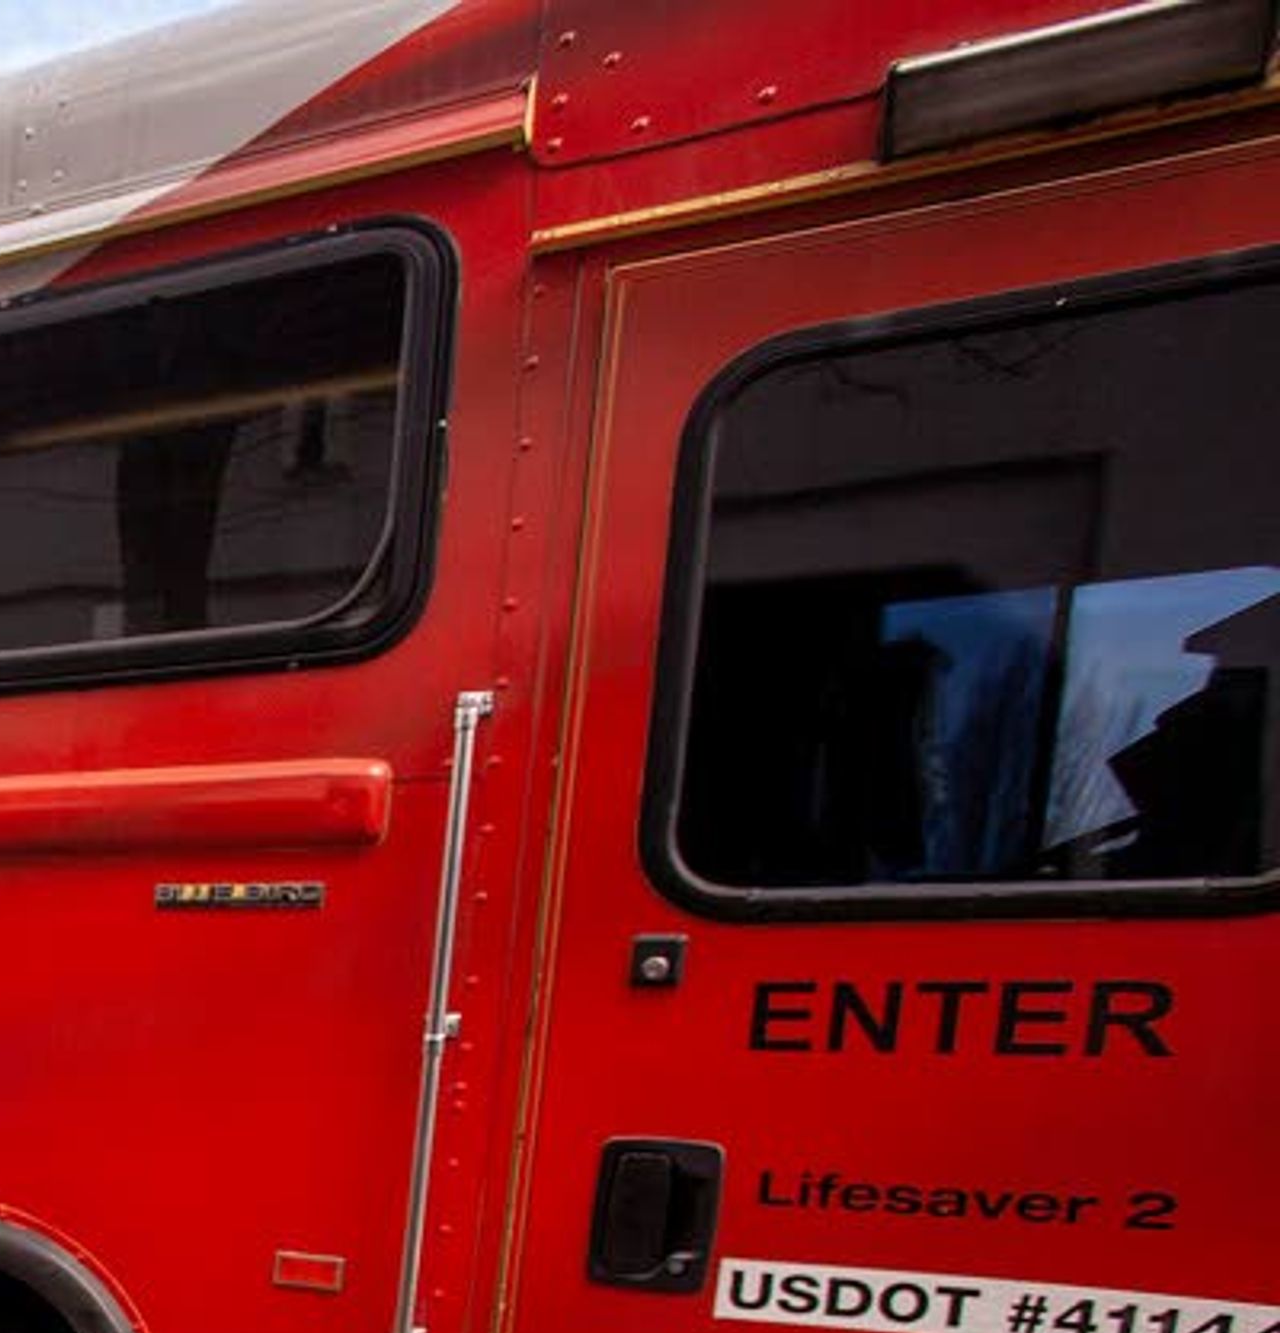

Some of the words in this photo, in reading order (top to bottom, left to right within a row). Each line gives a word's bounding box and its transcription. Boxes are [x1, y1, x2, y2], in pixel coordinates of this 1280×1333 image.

[748, 979, 1176, 1058] ENTER
[757, 1170, 1100, 1224] Lifesaver
[1124, 1192, 1179, 1231] 2
[728, 1270, 981, 1328] USDOT
